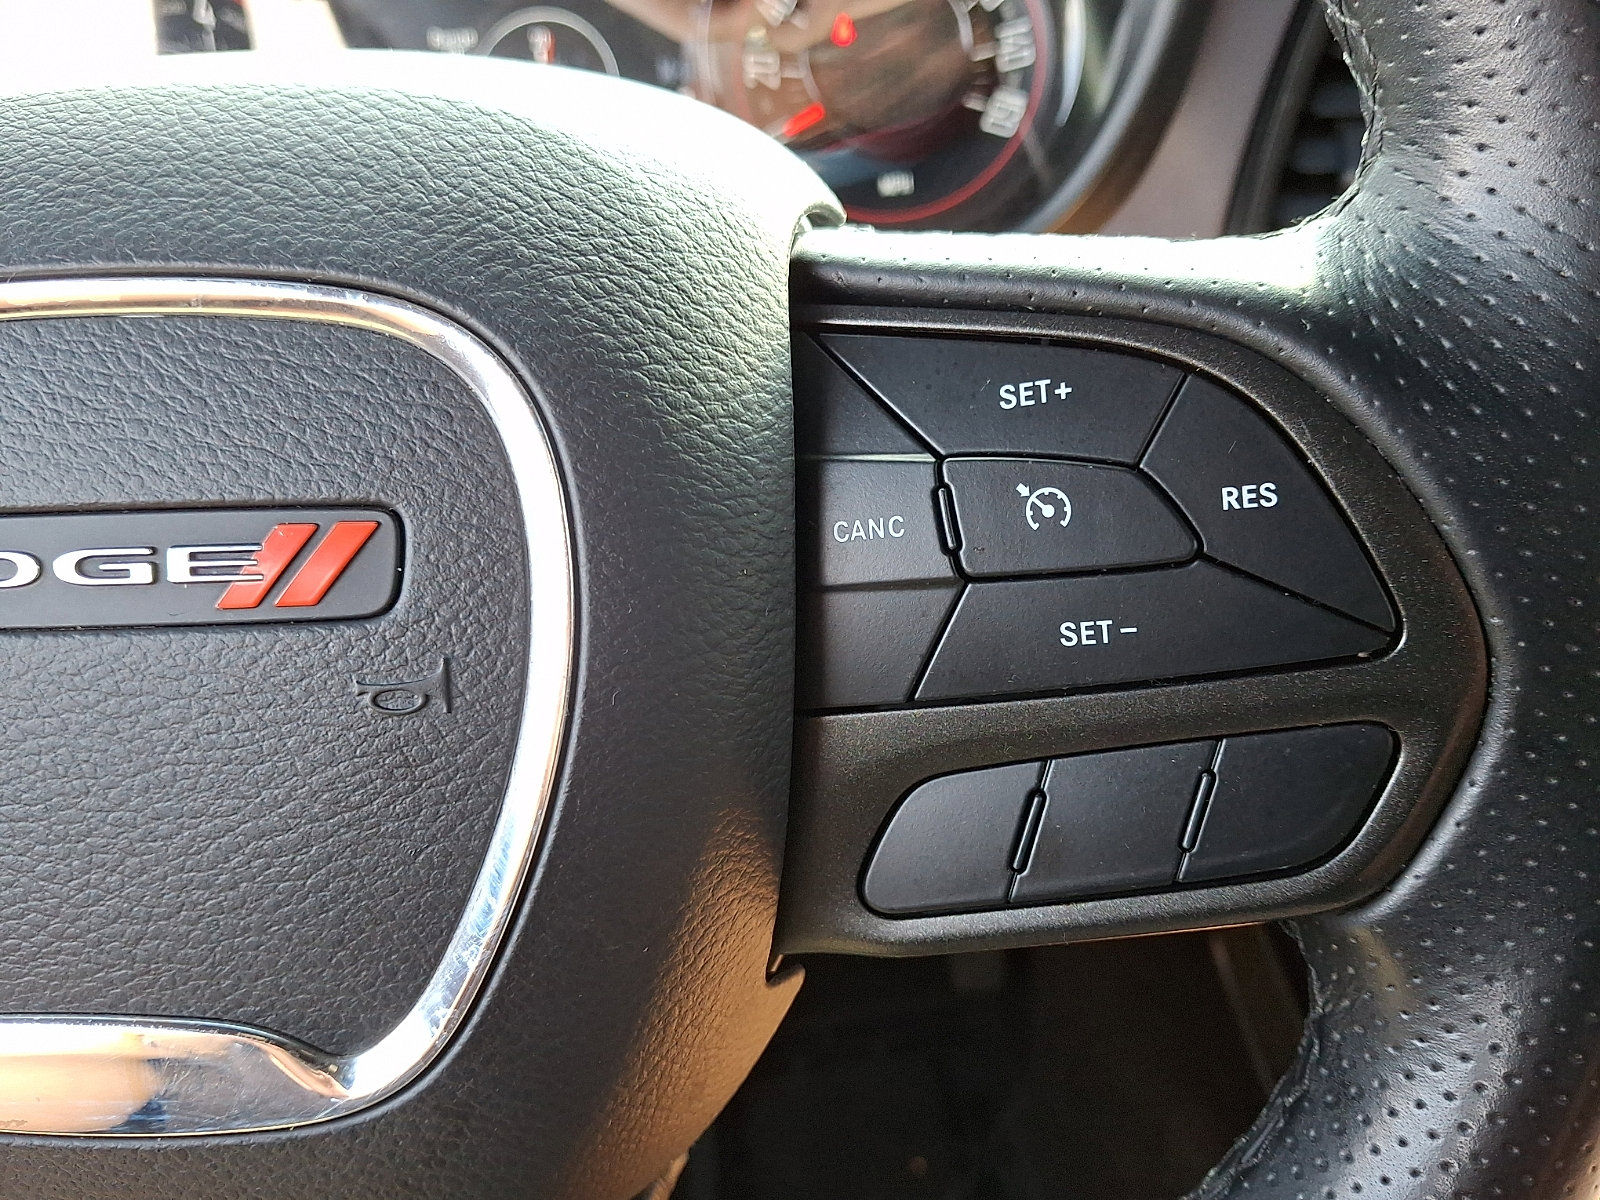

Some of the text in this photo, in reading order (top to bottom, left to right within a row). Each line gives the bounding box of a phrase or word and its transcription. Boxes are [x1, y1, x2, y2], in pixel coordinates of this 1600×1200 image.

[999, 379, 1073, 410] SET+
[1221, 482, 1278, 511] RES
[833, 515, 905, 543] CANC
